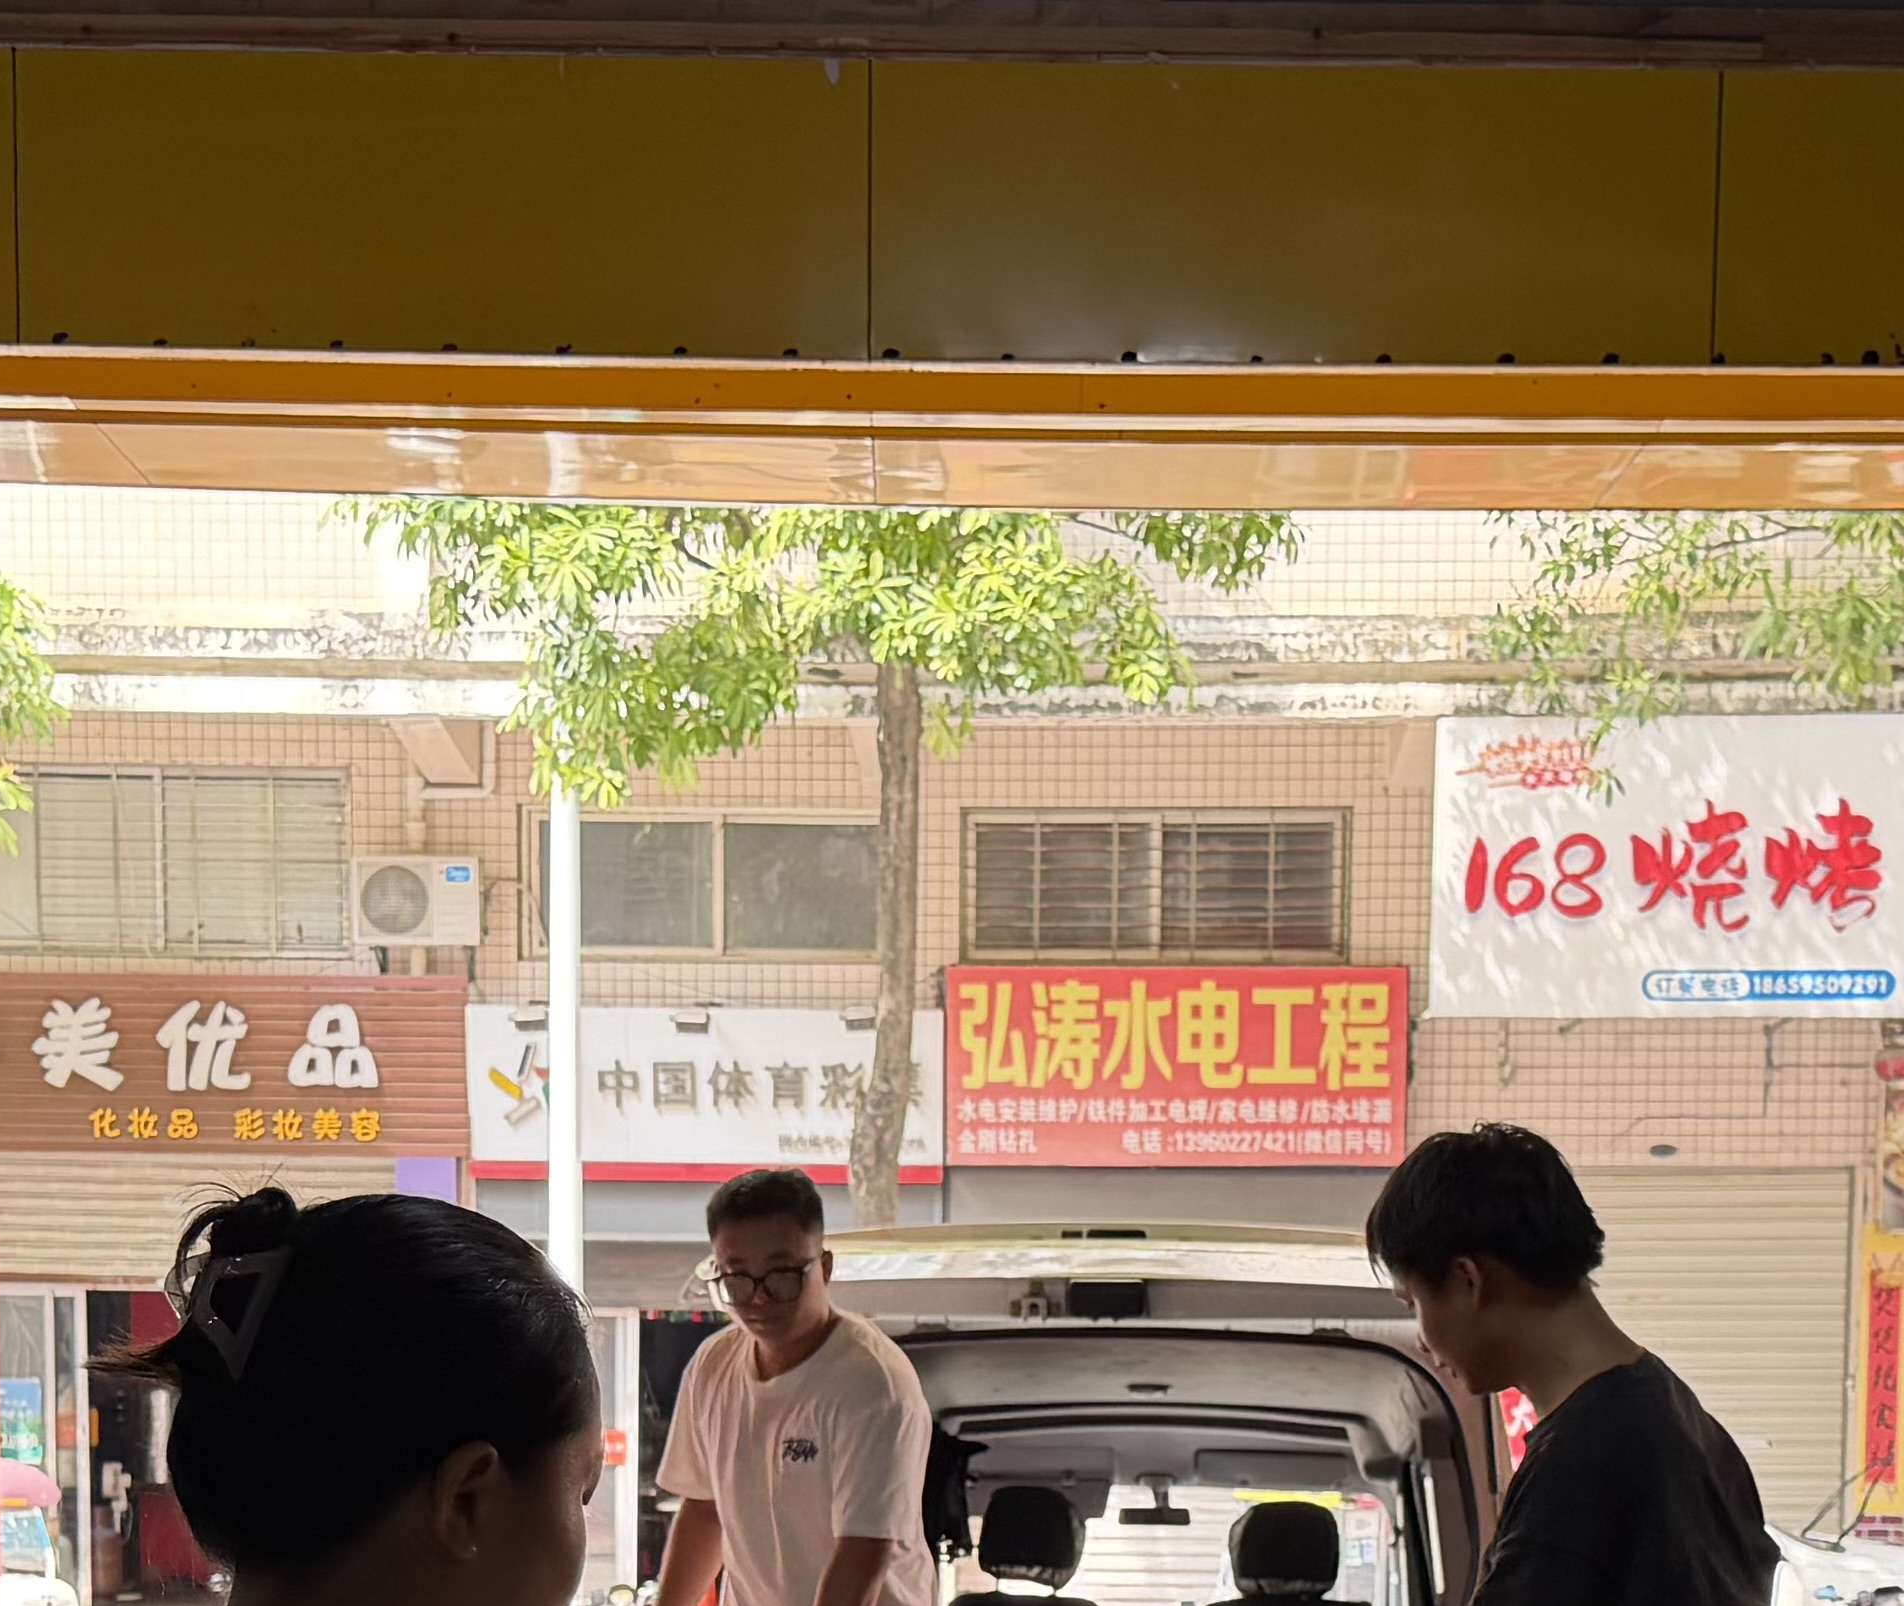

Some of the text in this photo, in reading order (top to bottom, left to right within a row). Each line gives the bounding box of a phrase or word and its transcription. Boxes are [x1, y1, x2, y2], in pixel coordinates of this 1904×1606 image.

[1750, 975, 1889, 997] 18659509291
[958, 979, 1391, 1091] 弘涛水电工程
[89, 1106, 382, 1143] 化妆品 彩妆美容
